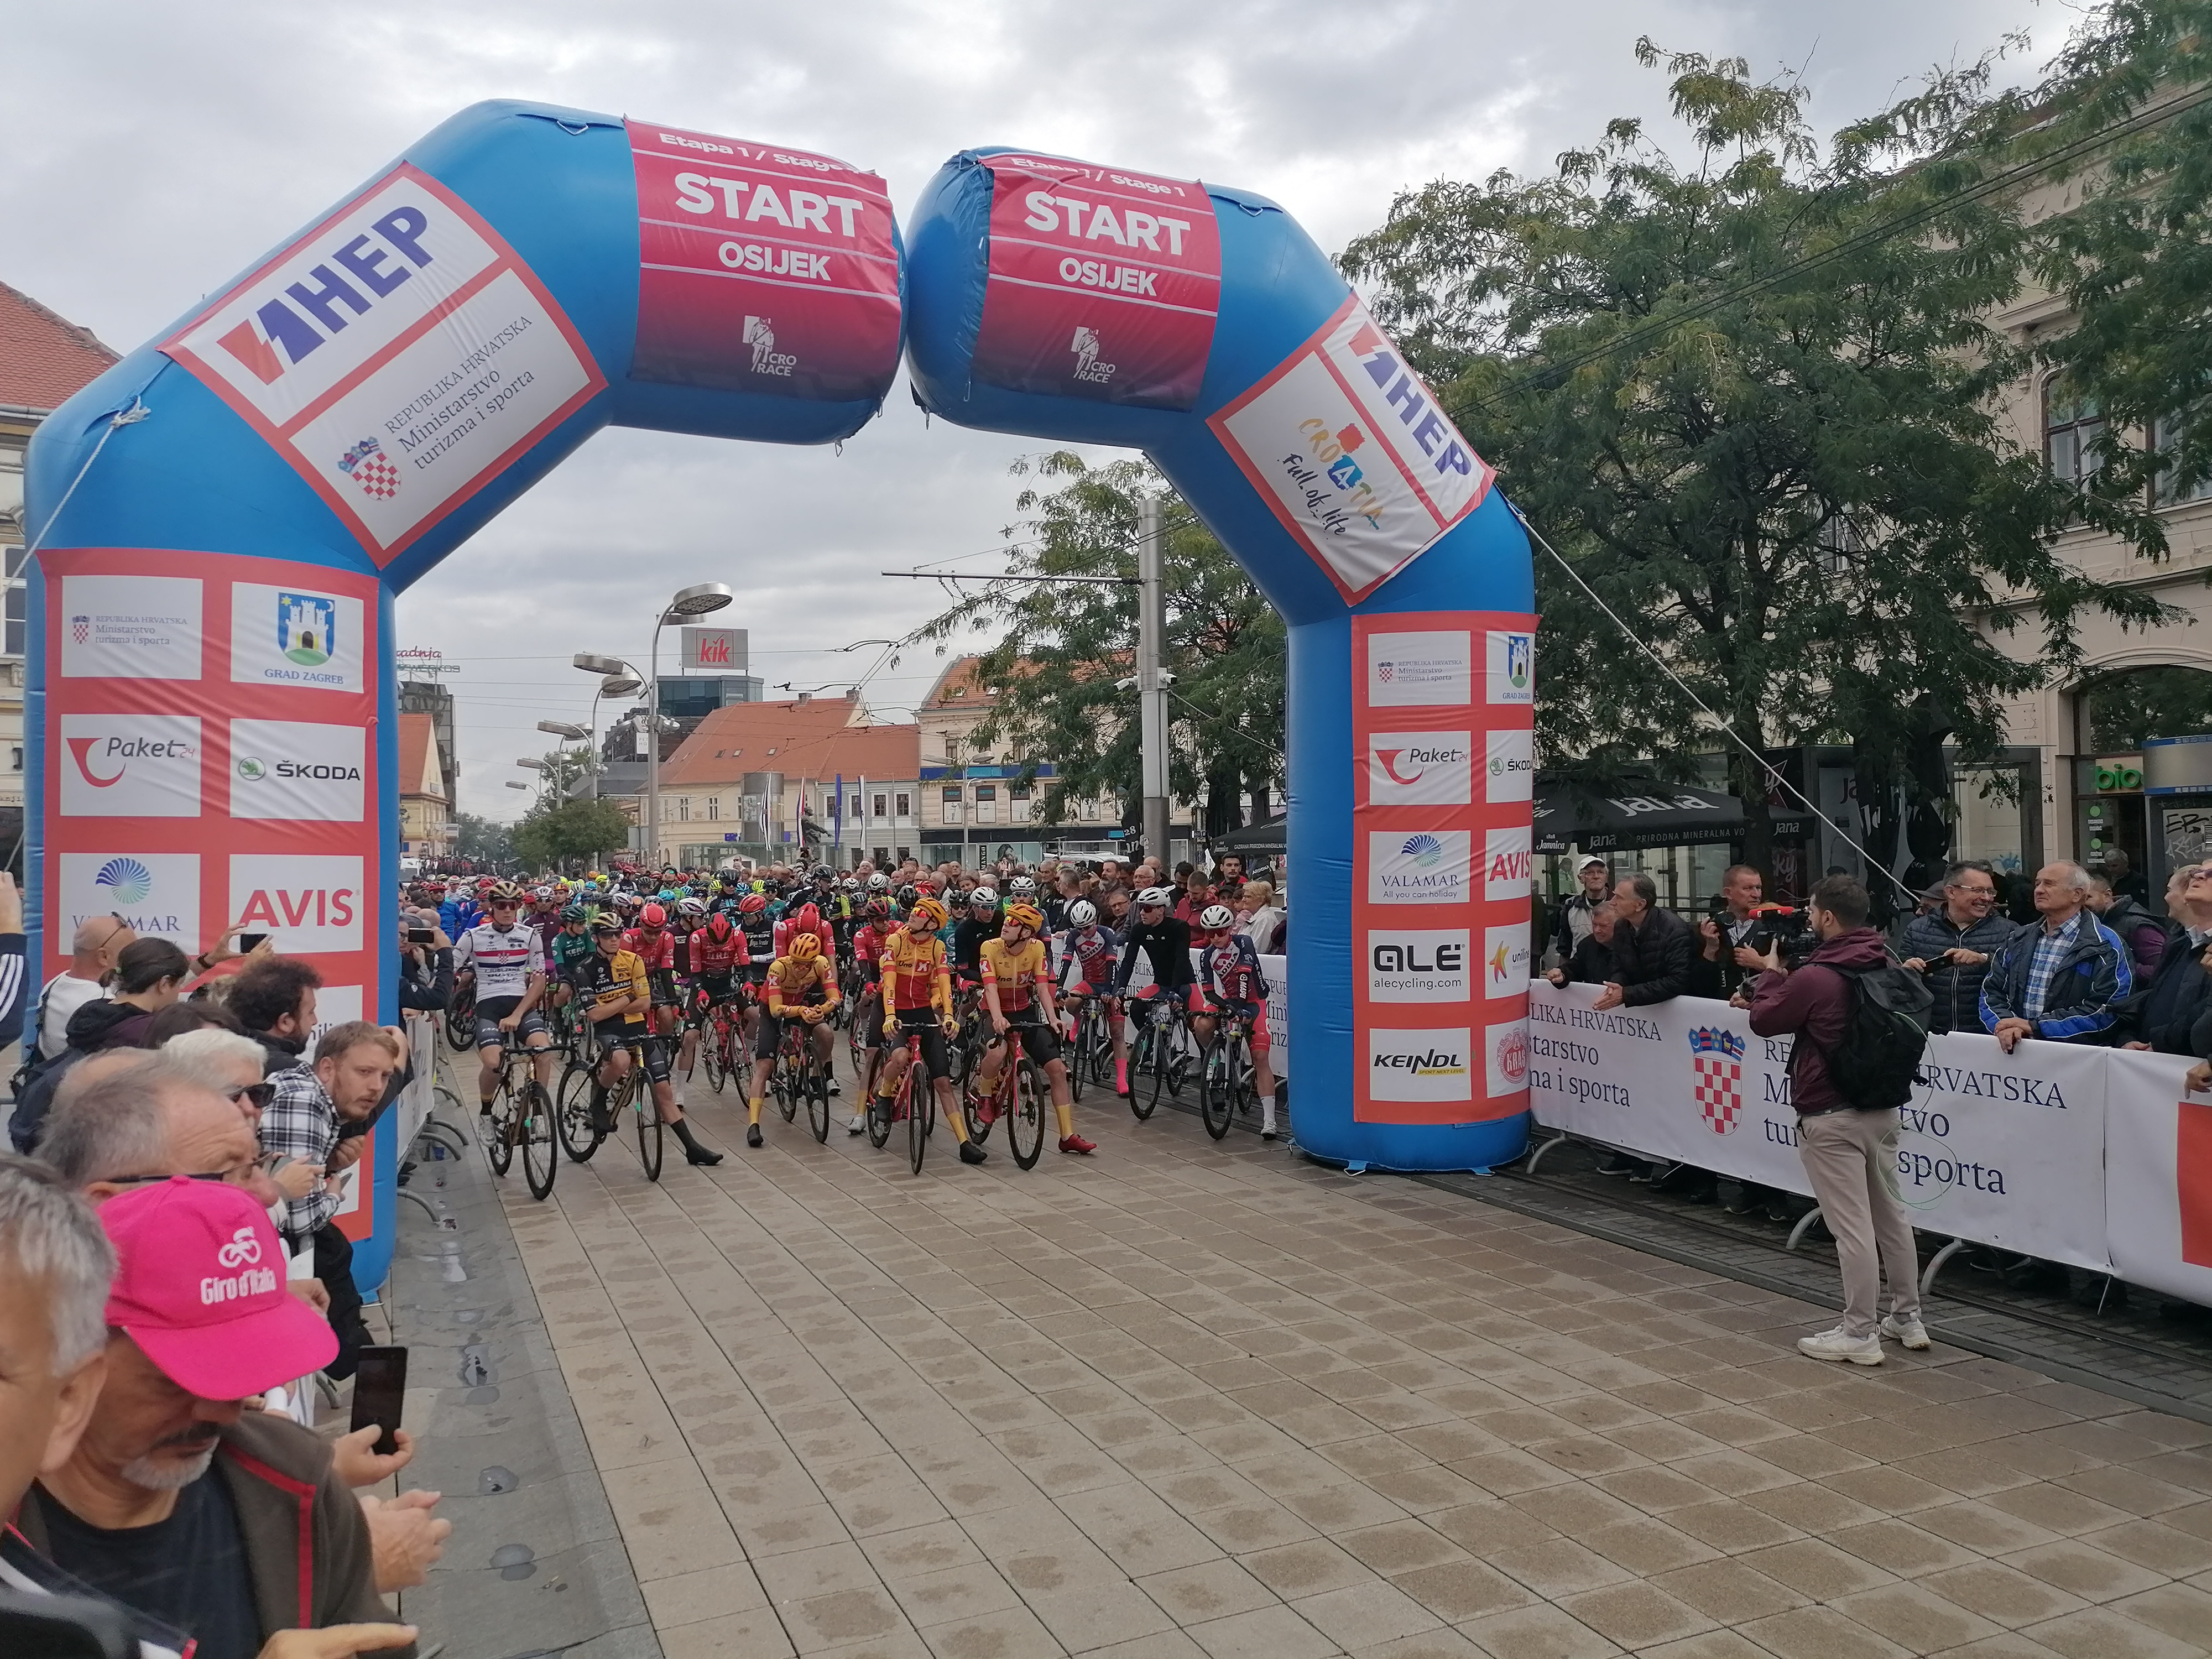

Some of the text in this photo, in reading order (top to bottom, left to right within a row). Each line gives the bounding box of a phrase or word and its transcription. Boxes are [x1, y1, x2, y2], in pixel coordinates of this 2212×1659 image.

[659, 133, 733, 155] Etapa
[737, 147, 750, 157] 1
[1110, 174, 1171, 194] Stage
[1174, 186, 1186, 197] 1
[674, 171, 863, 238] START
[1024, 190, 1191, 256] START
[284, 206, 434, 334] HEP
[718, 241, 831, 281] OSIJEK
[1059, 257, 1159, 296] OSIJEK
[757, 363, 792, 377] RACE
[769, 353, 797, 366] CRO
[1091, 361, 1116, 373] CRO
[384, 315, 533, 435] REPUBLIKA HRVATSKA
[1078, 371, 1110, 384] RACE
[397, 370, 500, 453] Ministarstvo
[414, 369, 535, 469] turizma i sporta
[1385, 372, 1472, 476] HEP
[95, 624, 155, 635] Ministarstvo
[141, 617, 188, 625] HRVATSKA
[95, 635, 131, 644] turizma
[139, 637, 170, 647] sporta
[700, 633, 730, 664] kik
[264, 669, 344, 686] GRAD ZAGREB
[1398, 666, 1442, 675] Ministarstvo
[1431, 674, 1452, 682] sporta
[106, 737, 186, 759] Paket
[1409, 748, 1463, 763] Paket
[276, 759, 361, 782] ŠKODA
[1536, 839, 1565, 851] Jamnica
[1636, 831, 1679, 843] PRIRODNA
[1682, 828, 1731, 840] MINERALNA
[1489, 849, 1531, 882] AVIS
[1381, 875, 1460, 888] VALAMAR
[1395, 892, 1410, 900] you
[1429, 889, 1458, 900] holiday
[238, 888, 354, 928] AVIS
[1081, 942, 1103, 961] ADRIA
[1218, 953, 1238, 978] ADRIA
[1374, 978, 1462, 990] alecycling.com
[1571, 1010, 1663, 1042] HRVATSKA
[1374, 1048, 1462, 1074] KEINDL
[1558, 1068, 1564, 1092] i
[1569, 1078, 1631, 1108] sporta
[1897, 1149, 2007, 1196] sporta
[200, 1276, 238, 1305] Giro
